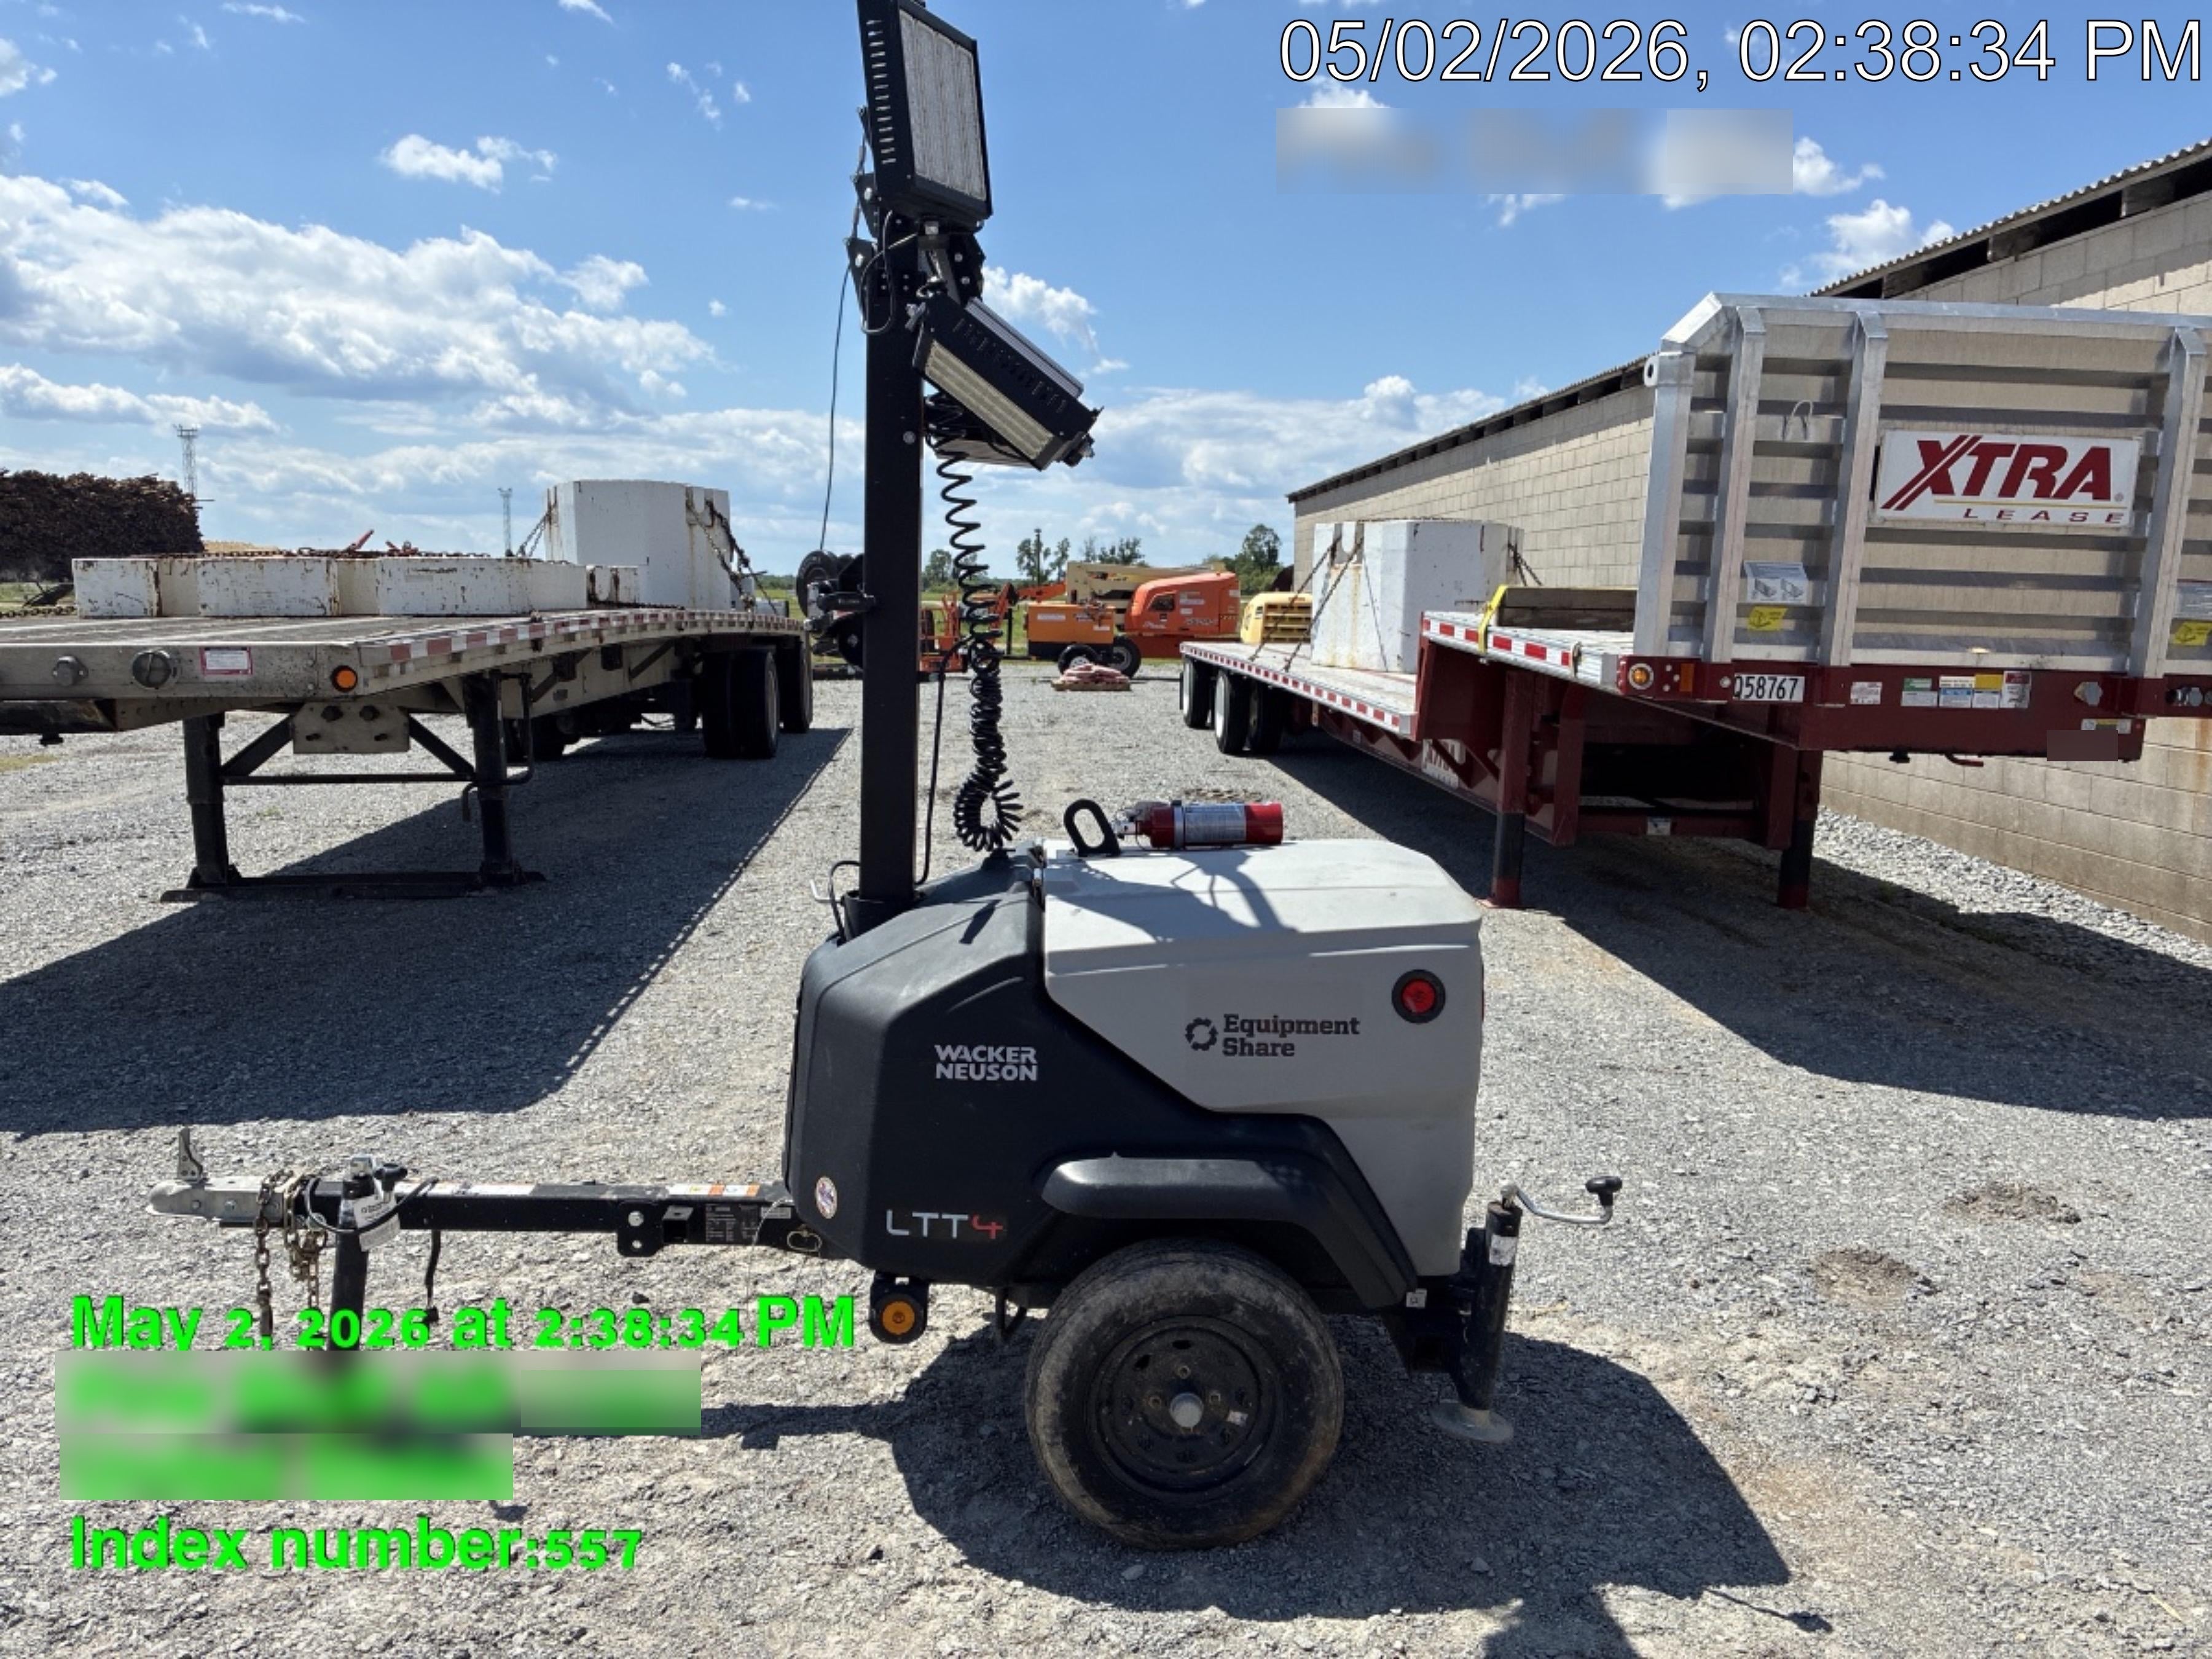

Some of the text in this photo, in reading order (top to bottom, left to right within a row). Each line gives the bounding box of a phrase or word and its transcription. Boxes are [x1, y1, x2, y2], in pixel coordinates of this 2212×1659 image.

[1881, 434, 2111, 511] XTRA
[1963, 508, 2125, 525] LEASE
[1223, 1013, 1360, 1038] Equipment
[933, 1044, 1038, 1064] WACKER
[1222, 1037, 1295, 1057] Share
[935, 1062, 1038, 1081] NEUSON
[885, 1209, 1003, 1240] LTT4
